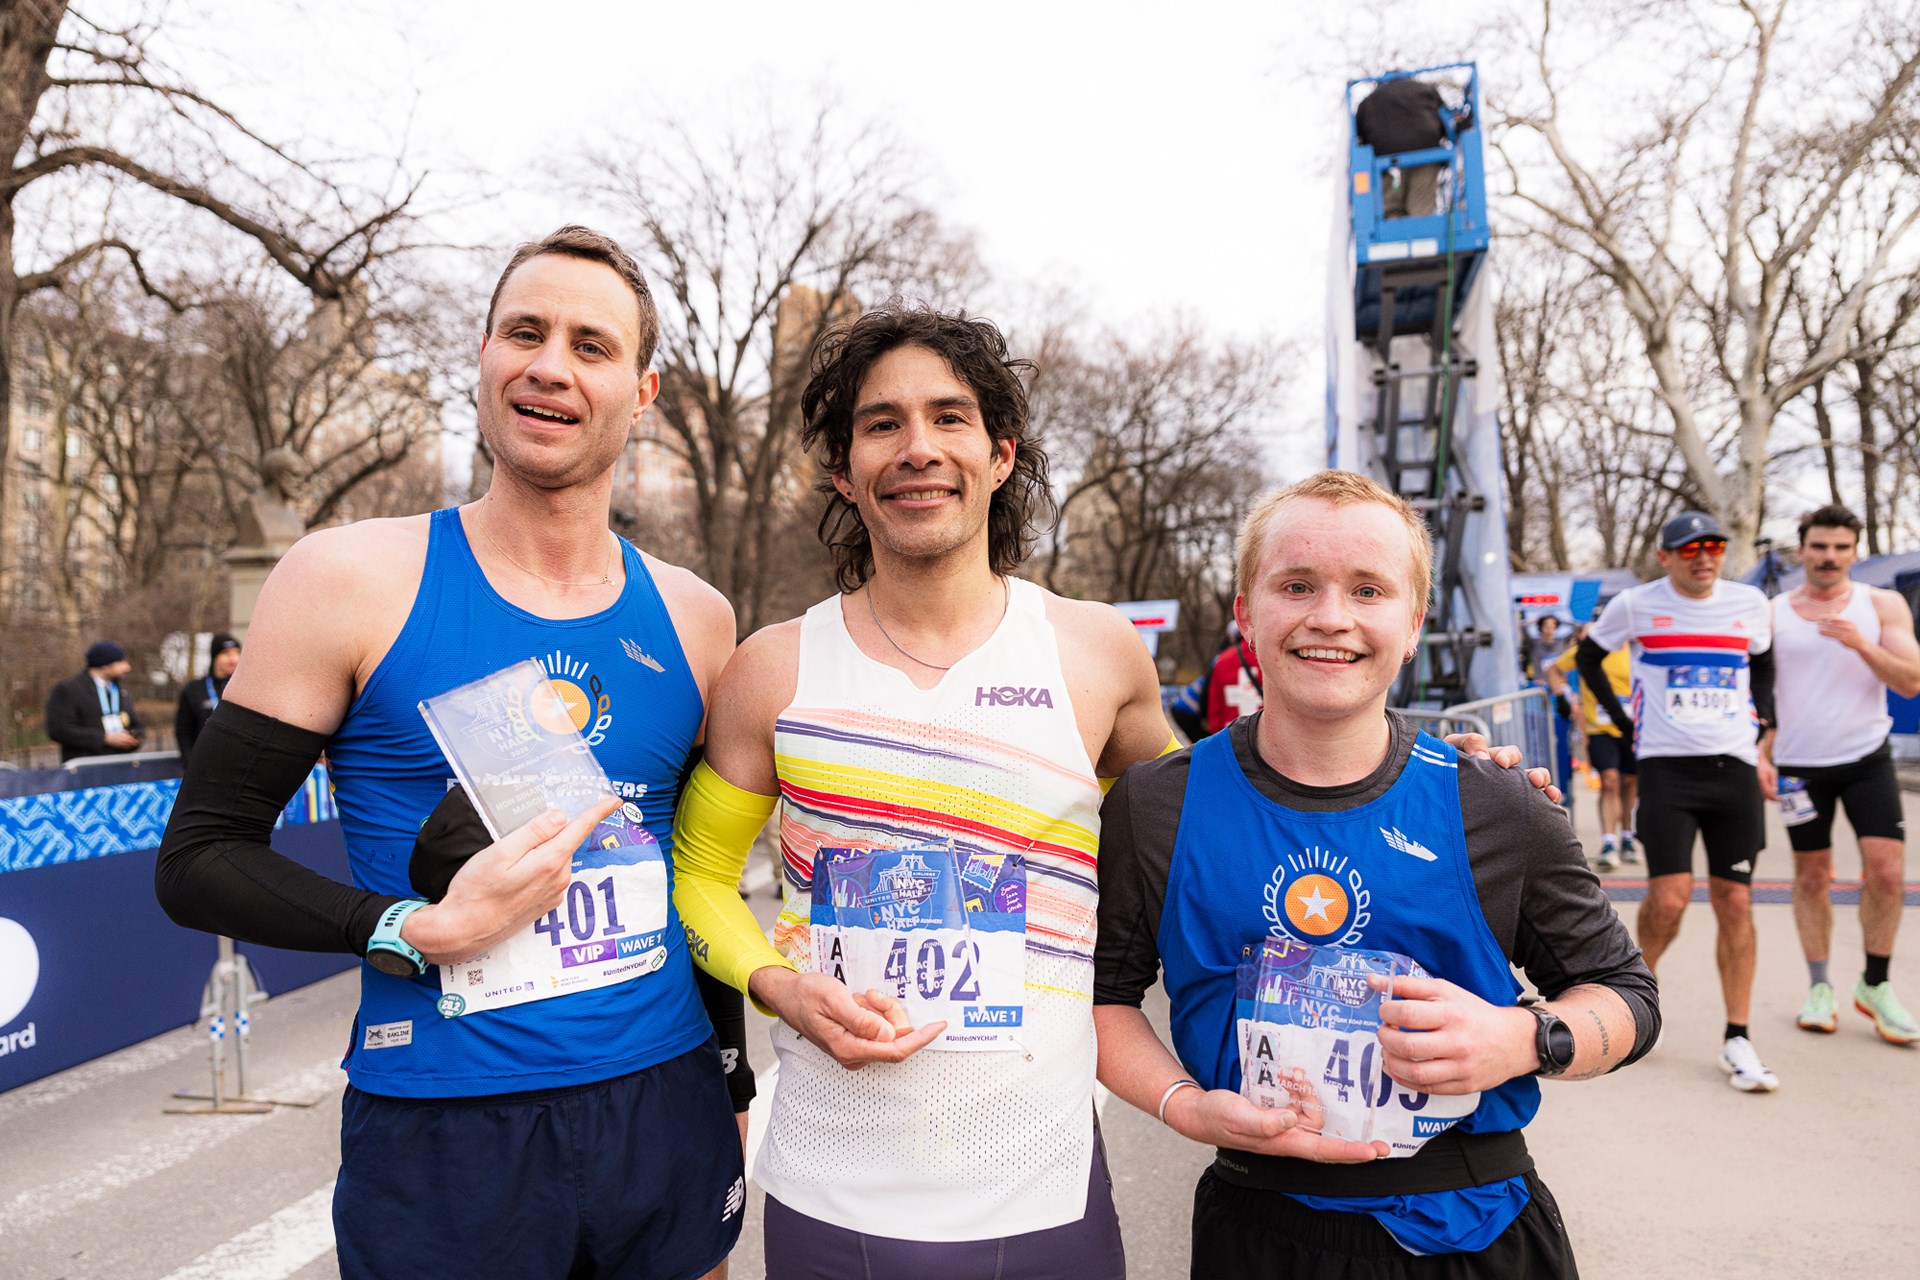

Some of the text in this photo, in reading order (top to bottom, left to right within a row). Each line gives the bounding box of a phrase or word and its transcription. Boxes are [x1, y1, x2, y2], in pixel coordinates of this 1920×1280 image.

[975, 686, 1053, 709] HOKA
[865, 895, 891, 904] UNITED
[534, 876, 626, 946] 401
[571, 943, 605, 964] VIP
[620, 933, 662, 954] WAVE 1
[830, 936, 844, 962] A
[603, 959, 648, 977] #UnitedNYCHalf
[884, 938, 981, 1001] 402
[485, 985, 522, 998] UNITED
[1290, 985, 1315, 995] UNITED
[1338, 977, 1368, 991] NYC
[967, 1009, 1017, 1023] WAVE 1
[1300, 998, 1341, 1019] NYC
[945, 1034, 998, 1042] #UnitedNYCHalf
[1256, 1034, 1274, 1061] A
